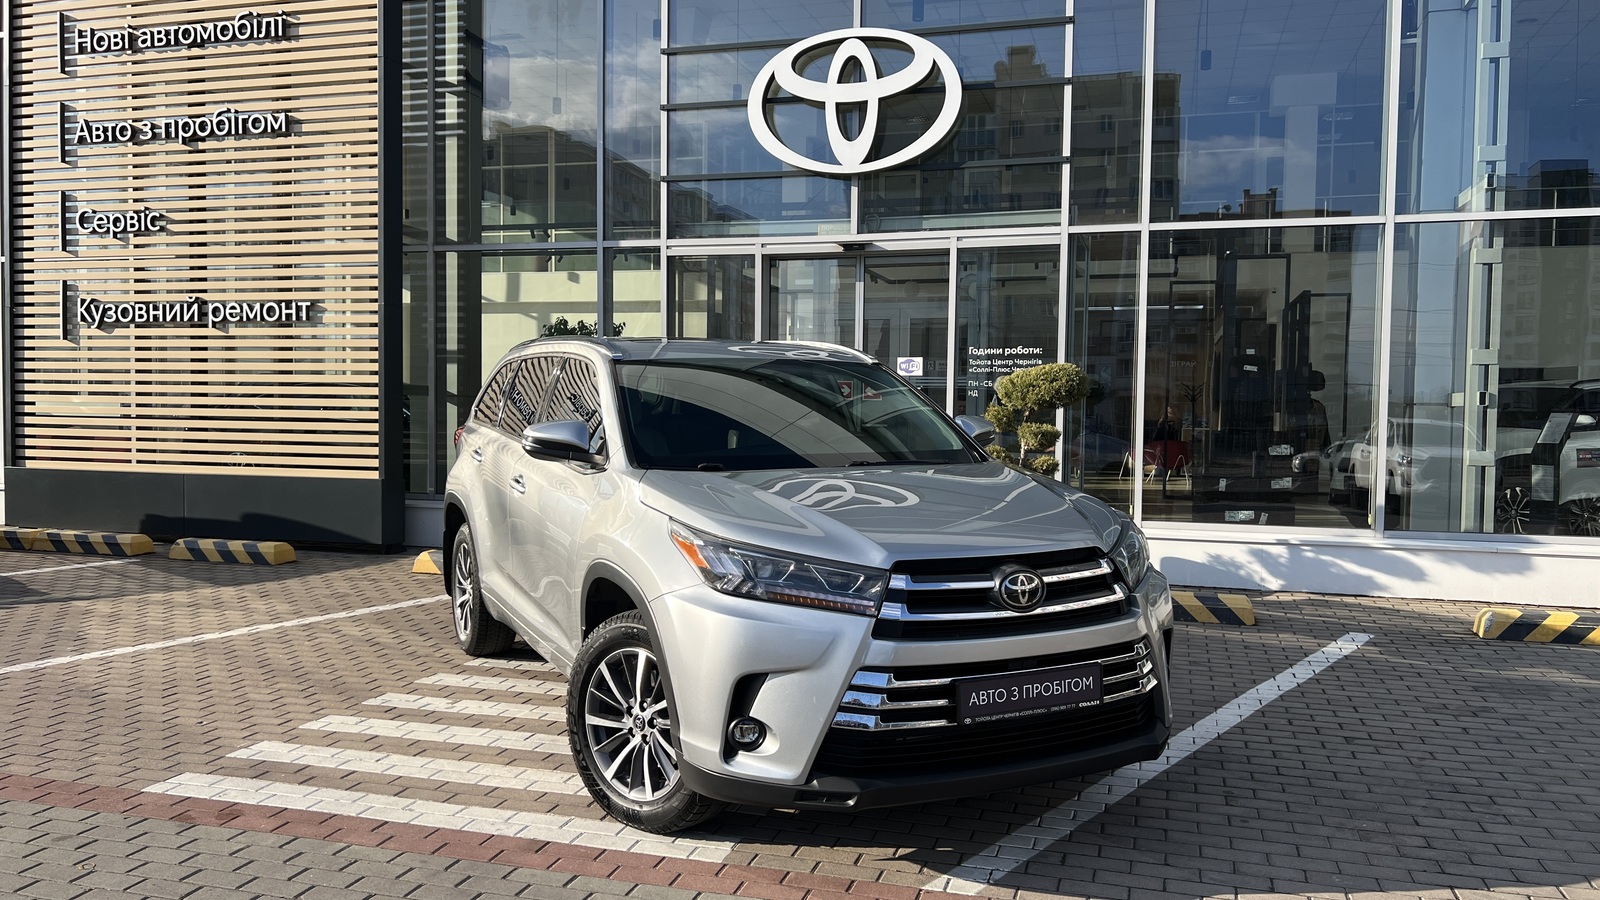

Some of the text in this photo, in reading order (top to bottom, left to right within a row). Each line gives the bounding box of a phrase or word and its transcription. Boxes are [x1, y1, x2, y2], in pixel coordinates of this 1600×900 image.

[74, 10, 285, 54] Нові автомобілі
[74, 107, 287, 145] Авто з пробігом
[75, 206, 161, 239] Сервіс
[76, 295, 311, 329] Кузовний ремонт
[968, 345, 1043, 357] Години роботи:
[968, 358, 992, 366] Тойота
[1014, 358, 1043, 366] Чернігів
[968, 389, 979, 397] НД
[968, 688, 1007, 707] АВТО
[1023, 676, 1094, 699] ПРОБІГОМ
